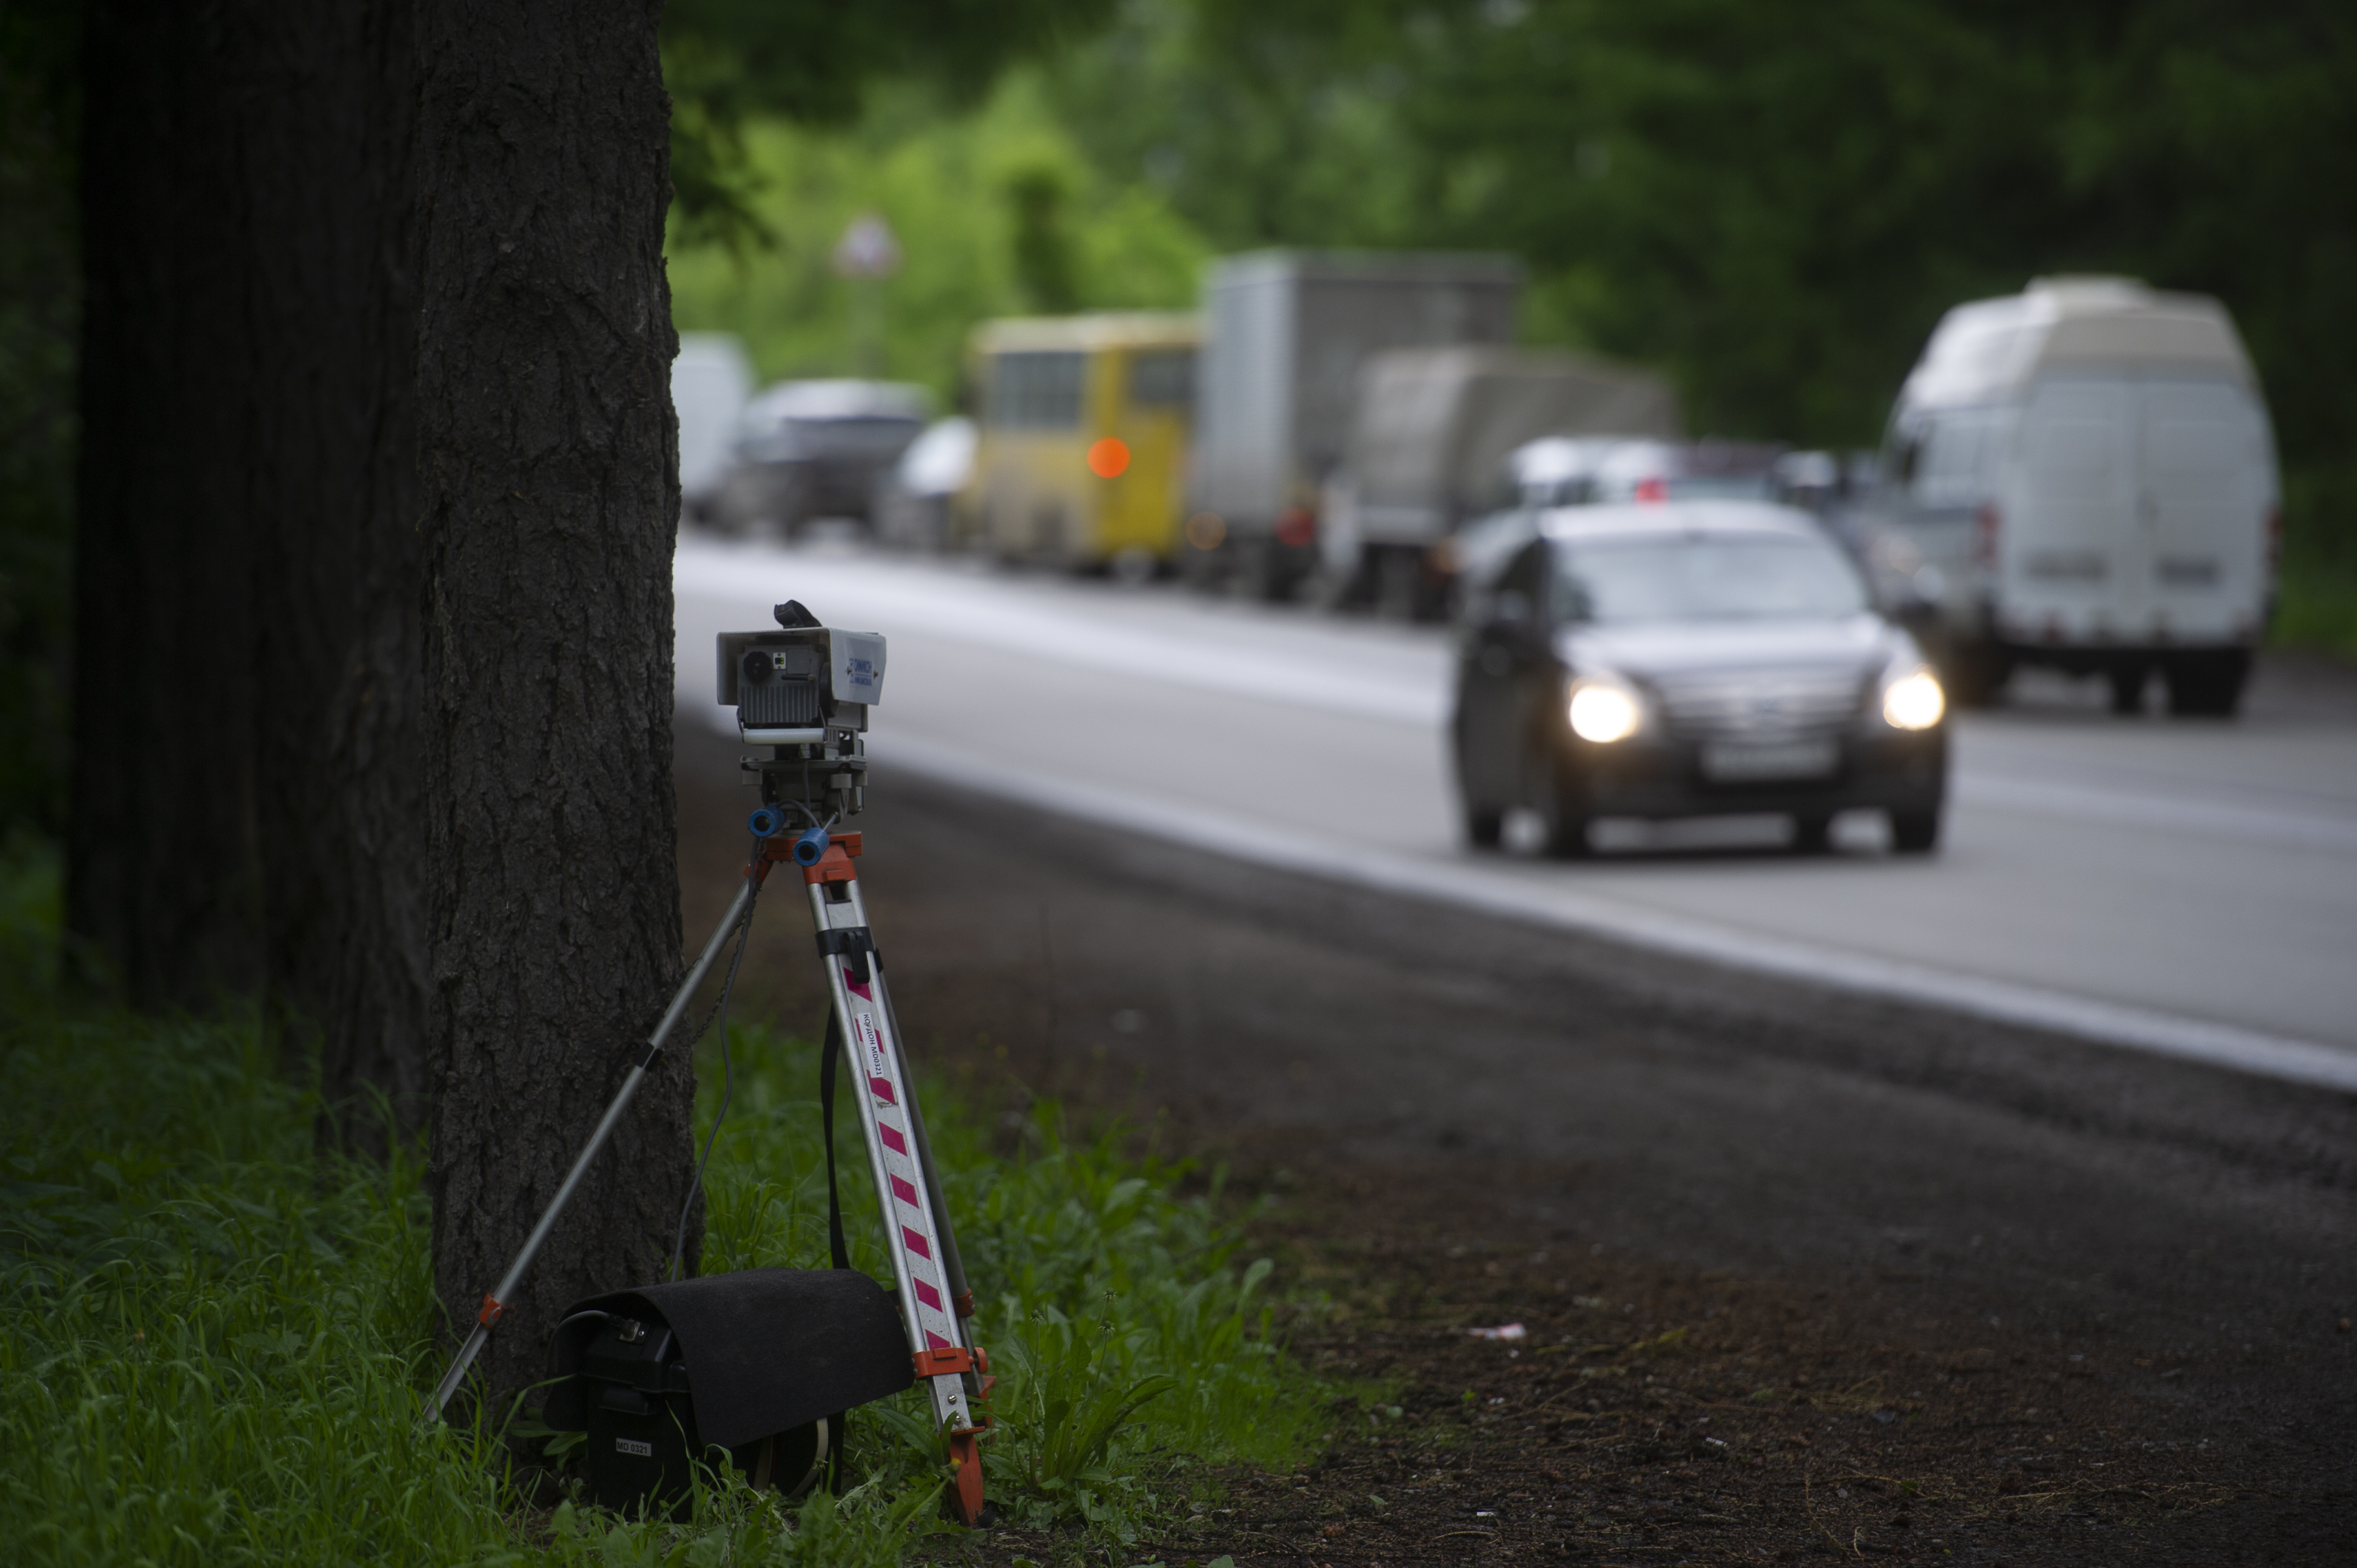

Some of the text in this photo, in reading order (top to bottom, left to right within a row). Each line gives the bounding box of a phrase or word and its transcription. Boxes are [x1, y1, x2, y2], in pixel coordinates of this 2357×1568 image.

[871, 1046, 882, 1075] MD0321
[617, 1442, 648, 1454] MD 0321
